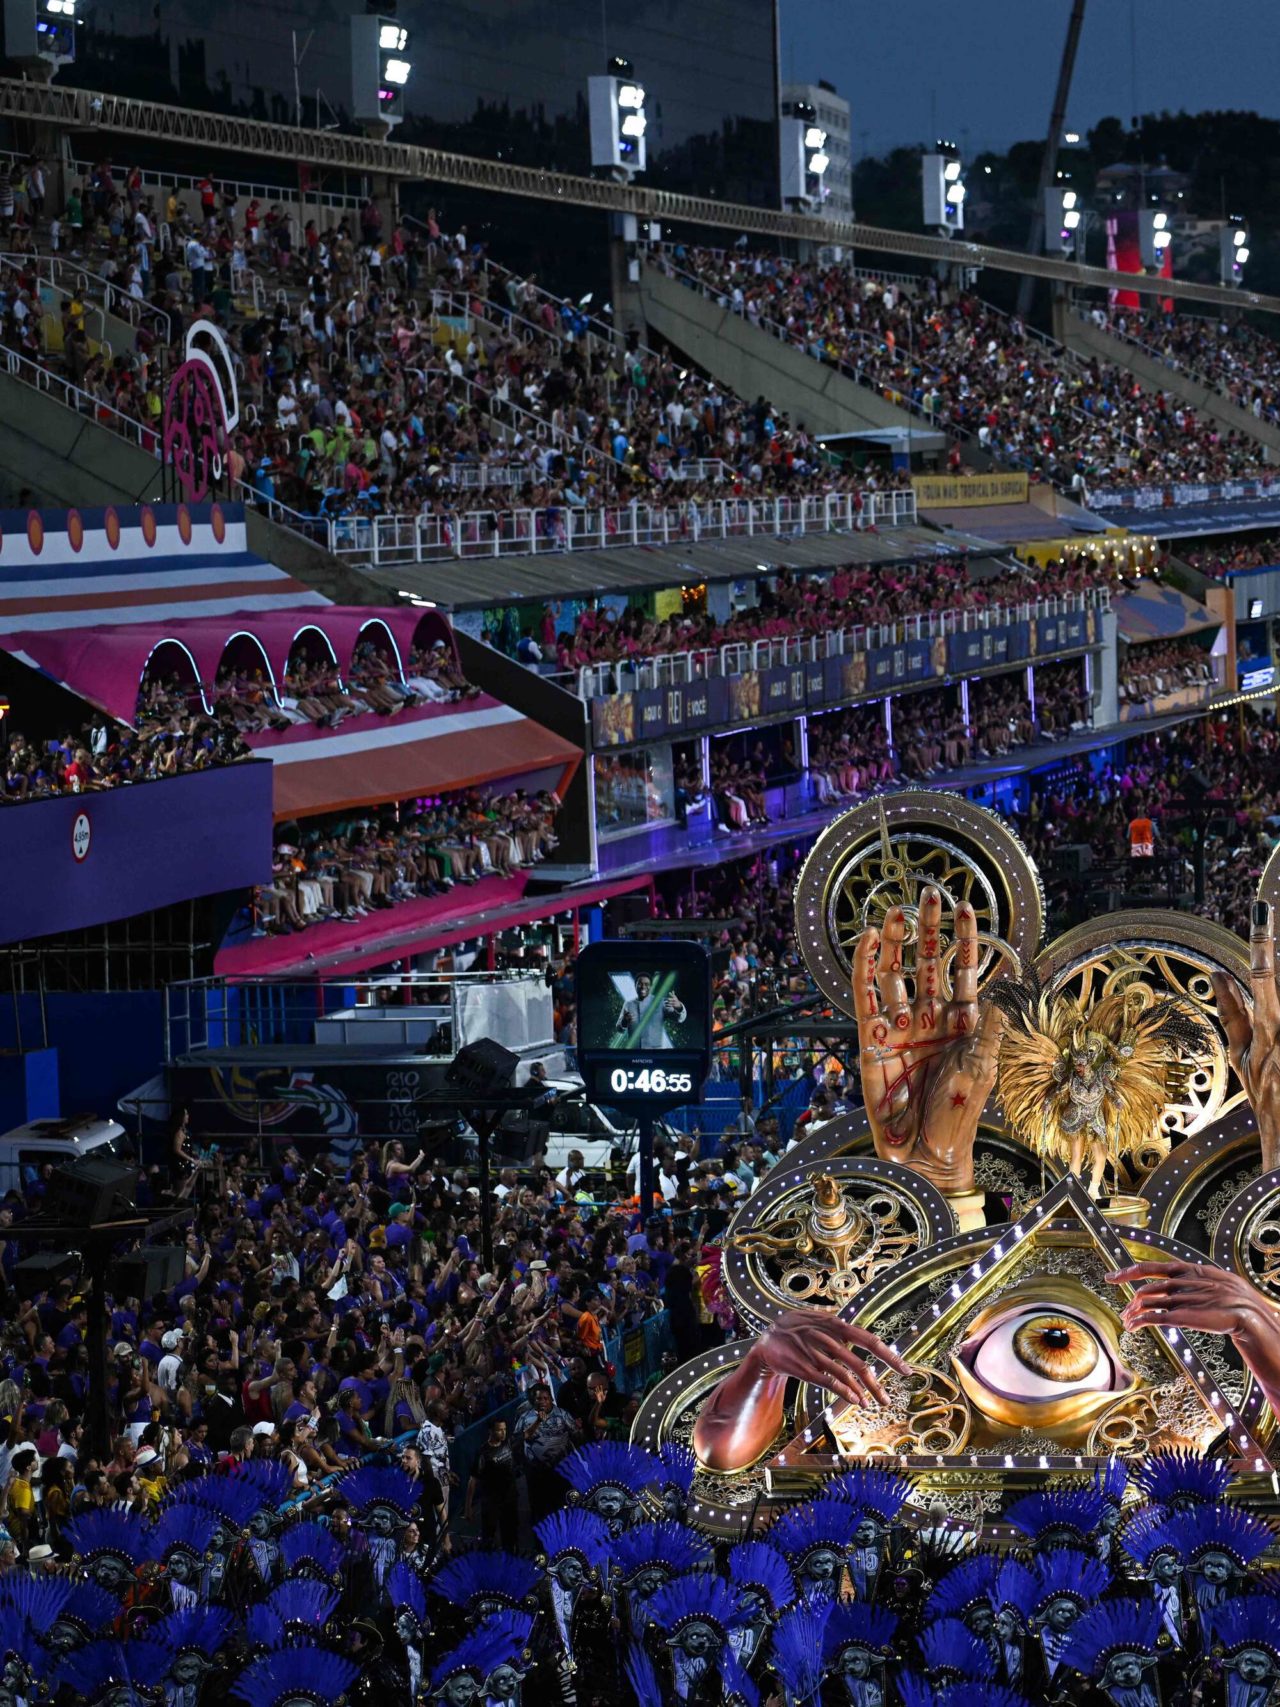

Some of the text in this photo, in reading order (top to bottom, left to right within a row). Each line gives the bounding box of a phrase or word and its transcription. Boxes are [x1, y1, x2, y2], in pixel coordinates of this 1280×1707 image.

[791, 671, 803, 701] REI
[643, 705, 657, 722] AQUI
[657, 705, 662, 720] O
[668, 691, 682, 724] REI
[611, 1069, 692, 1092] 0:46:55
